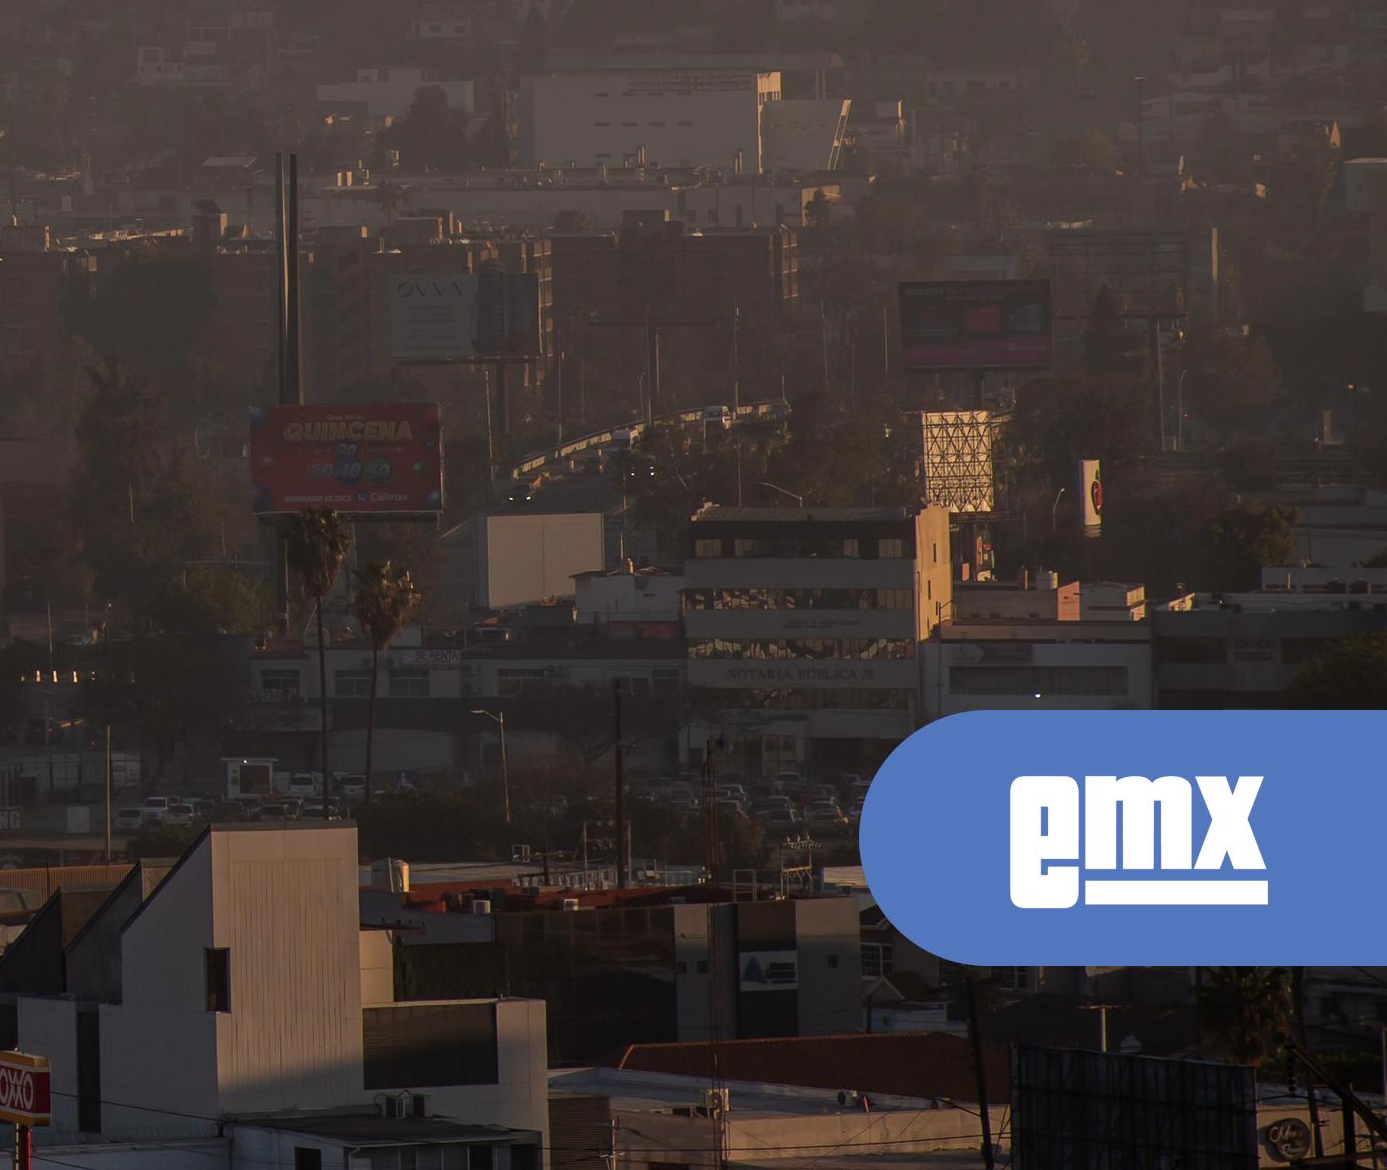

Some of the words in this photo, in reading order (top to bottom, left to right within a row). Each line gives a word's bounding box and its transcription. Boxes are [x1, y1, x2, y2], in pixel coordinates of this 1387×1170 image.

[283, 421, 413, 442] QUINCENA
[370, 491, 408, 503] Calimax
[429, 650, 460, 663] RENTA
